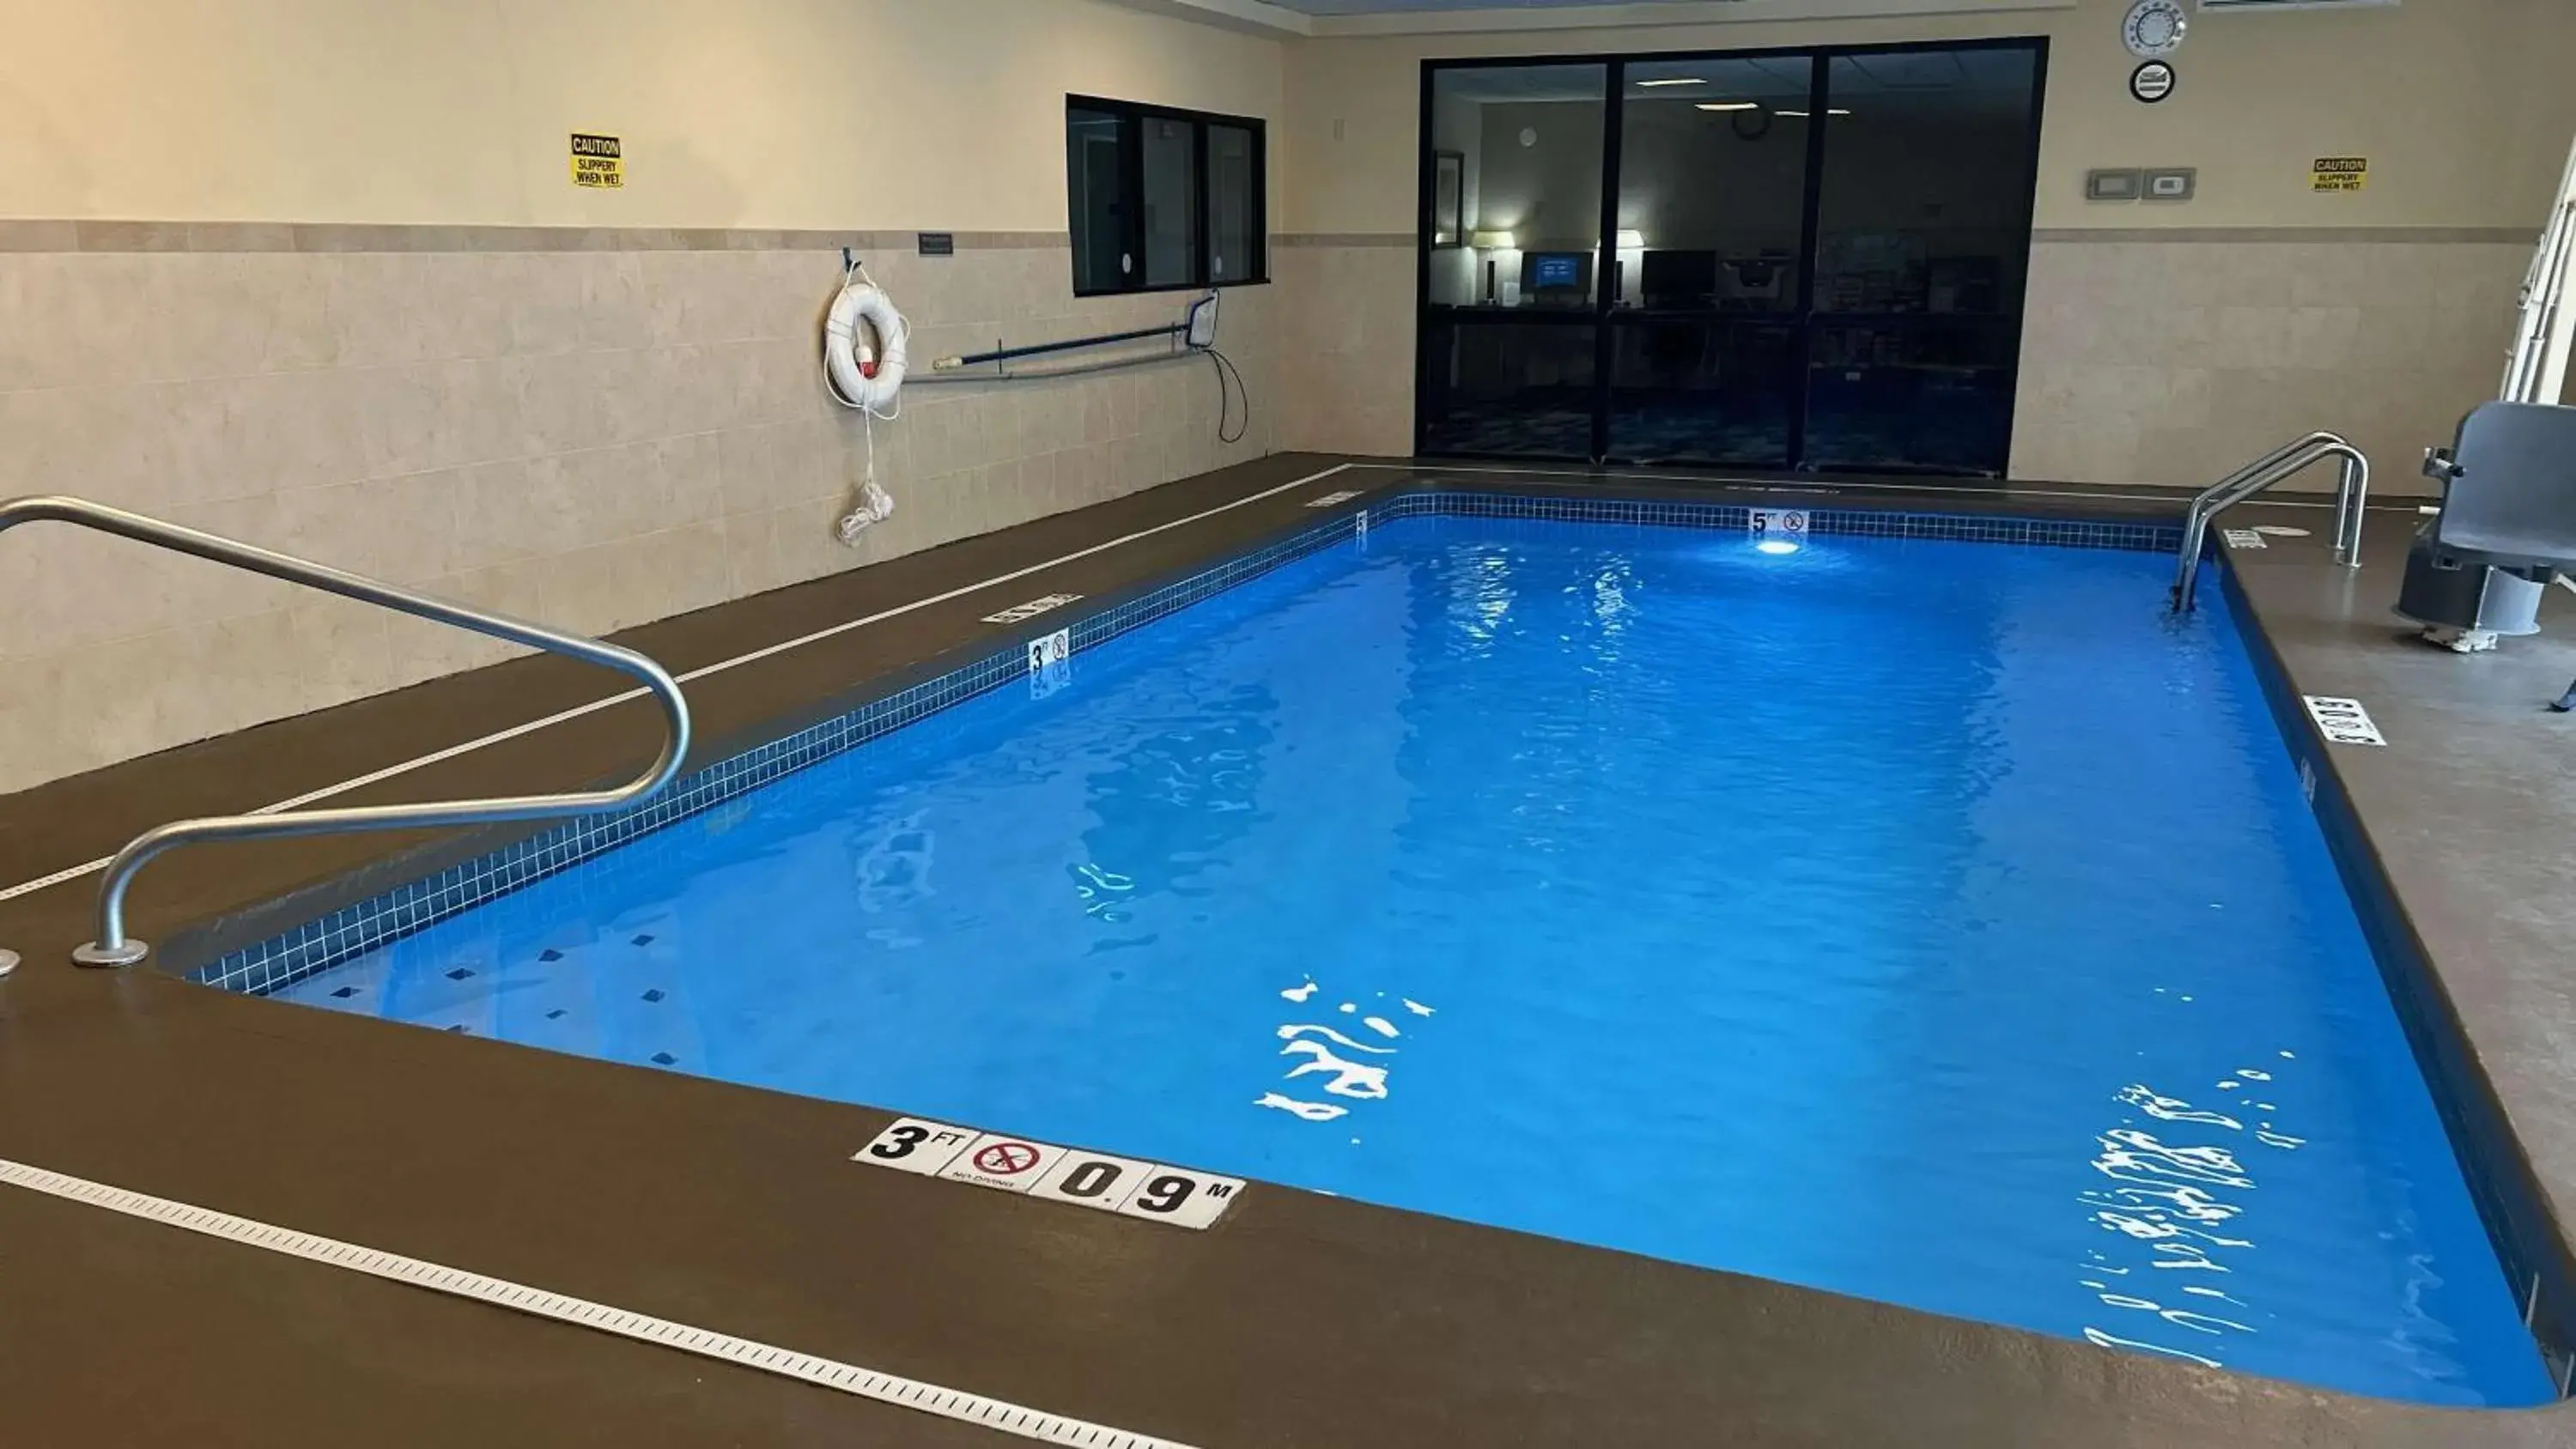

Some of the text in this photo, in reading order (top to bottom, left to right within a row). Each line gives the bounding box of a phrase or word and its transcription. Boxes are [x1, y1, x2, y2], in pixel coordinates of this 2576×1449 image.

[573, 137, 619, 155] CAUTION
[578, 158, 617, 172] SLIPPERY
[2316, 160, 2364, 170] CAUTION
[576, 171, 620, 185] WHEN WET
[1753, 512, 1766, 532] 5
[1033, 645, 1042, 670] 3
[870, 1125, 930, 1159] 3
[930, 1131, 966, 1146] FT
[1206, 1183, 1233, 1199] M
